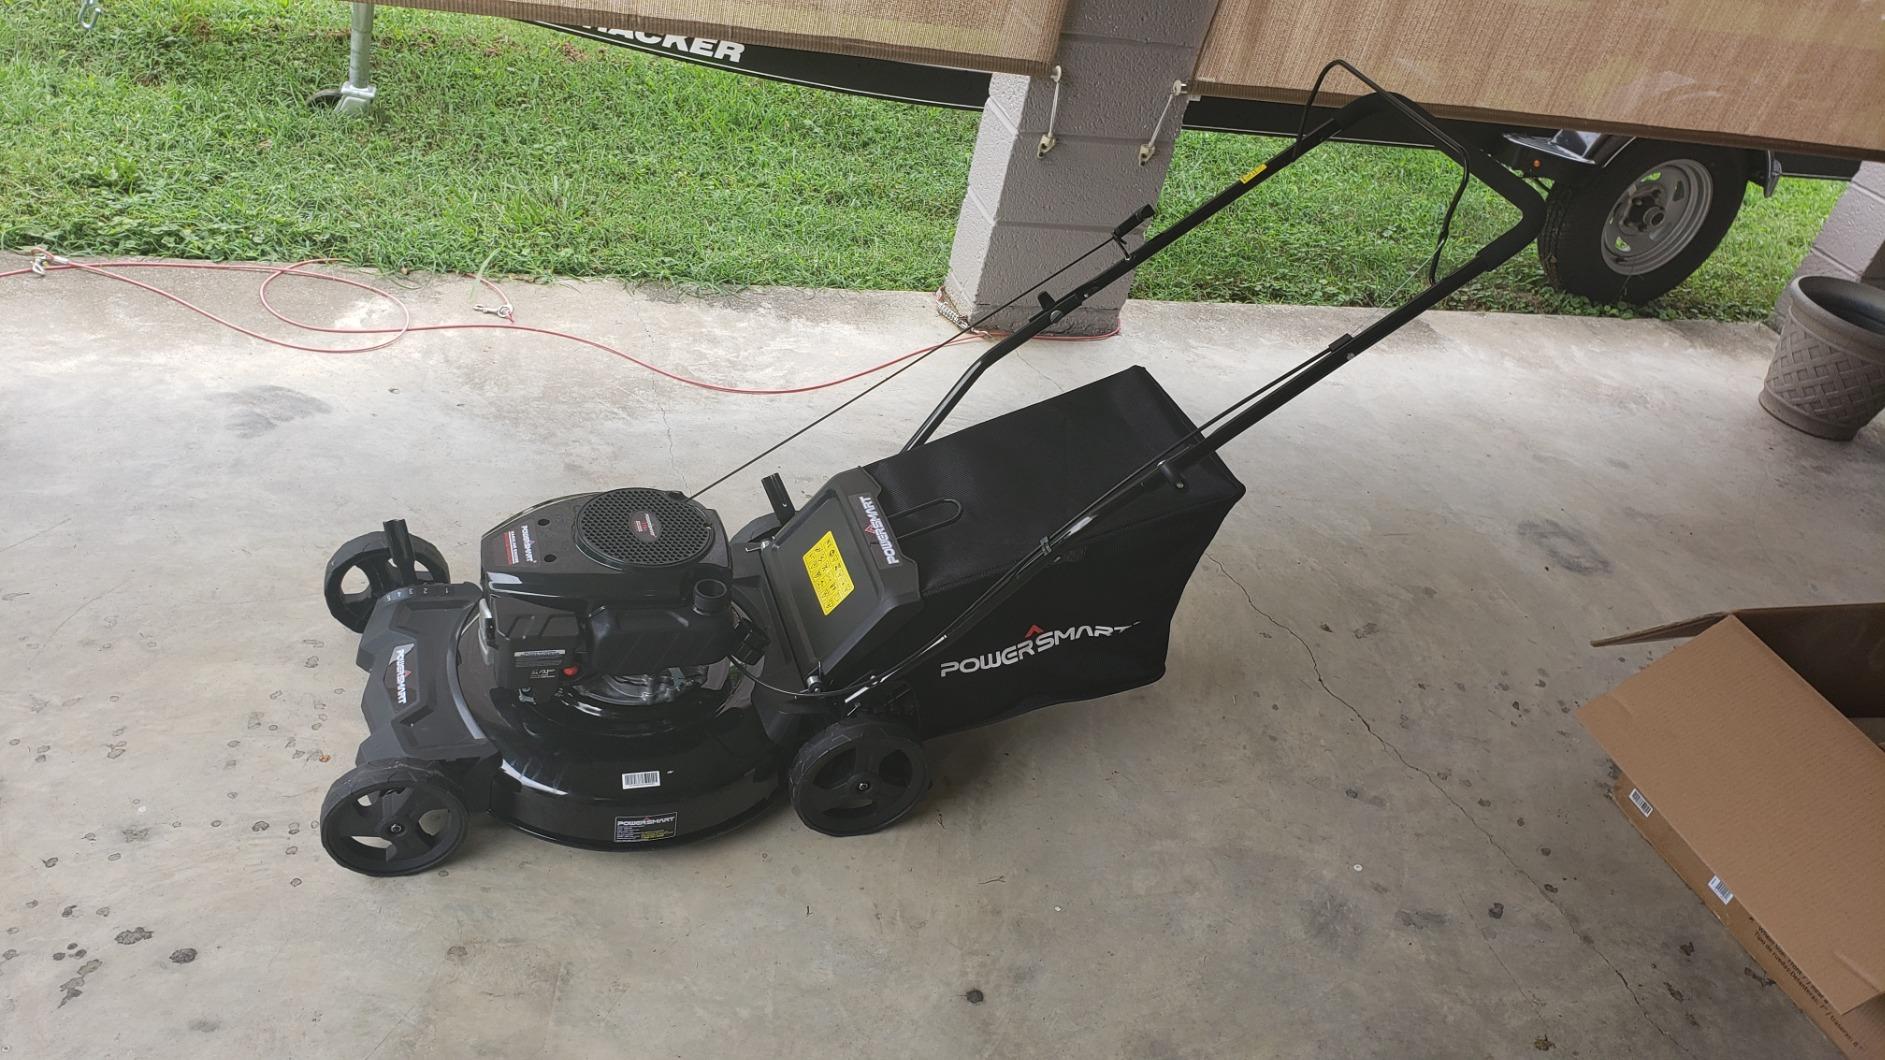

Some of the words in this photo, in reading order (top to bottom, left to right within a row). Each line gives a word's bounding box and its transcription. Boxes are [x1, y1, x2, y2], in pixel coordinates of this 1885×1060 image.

[860, 496, 899, 565] POWERSMART
[396, 649, 407, 704] POWERSMART
[940, 621, 1141, 678] POWERSMART
[617, 816, 675, 826] POWERSMART
